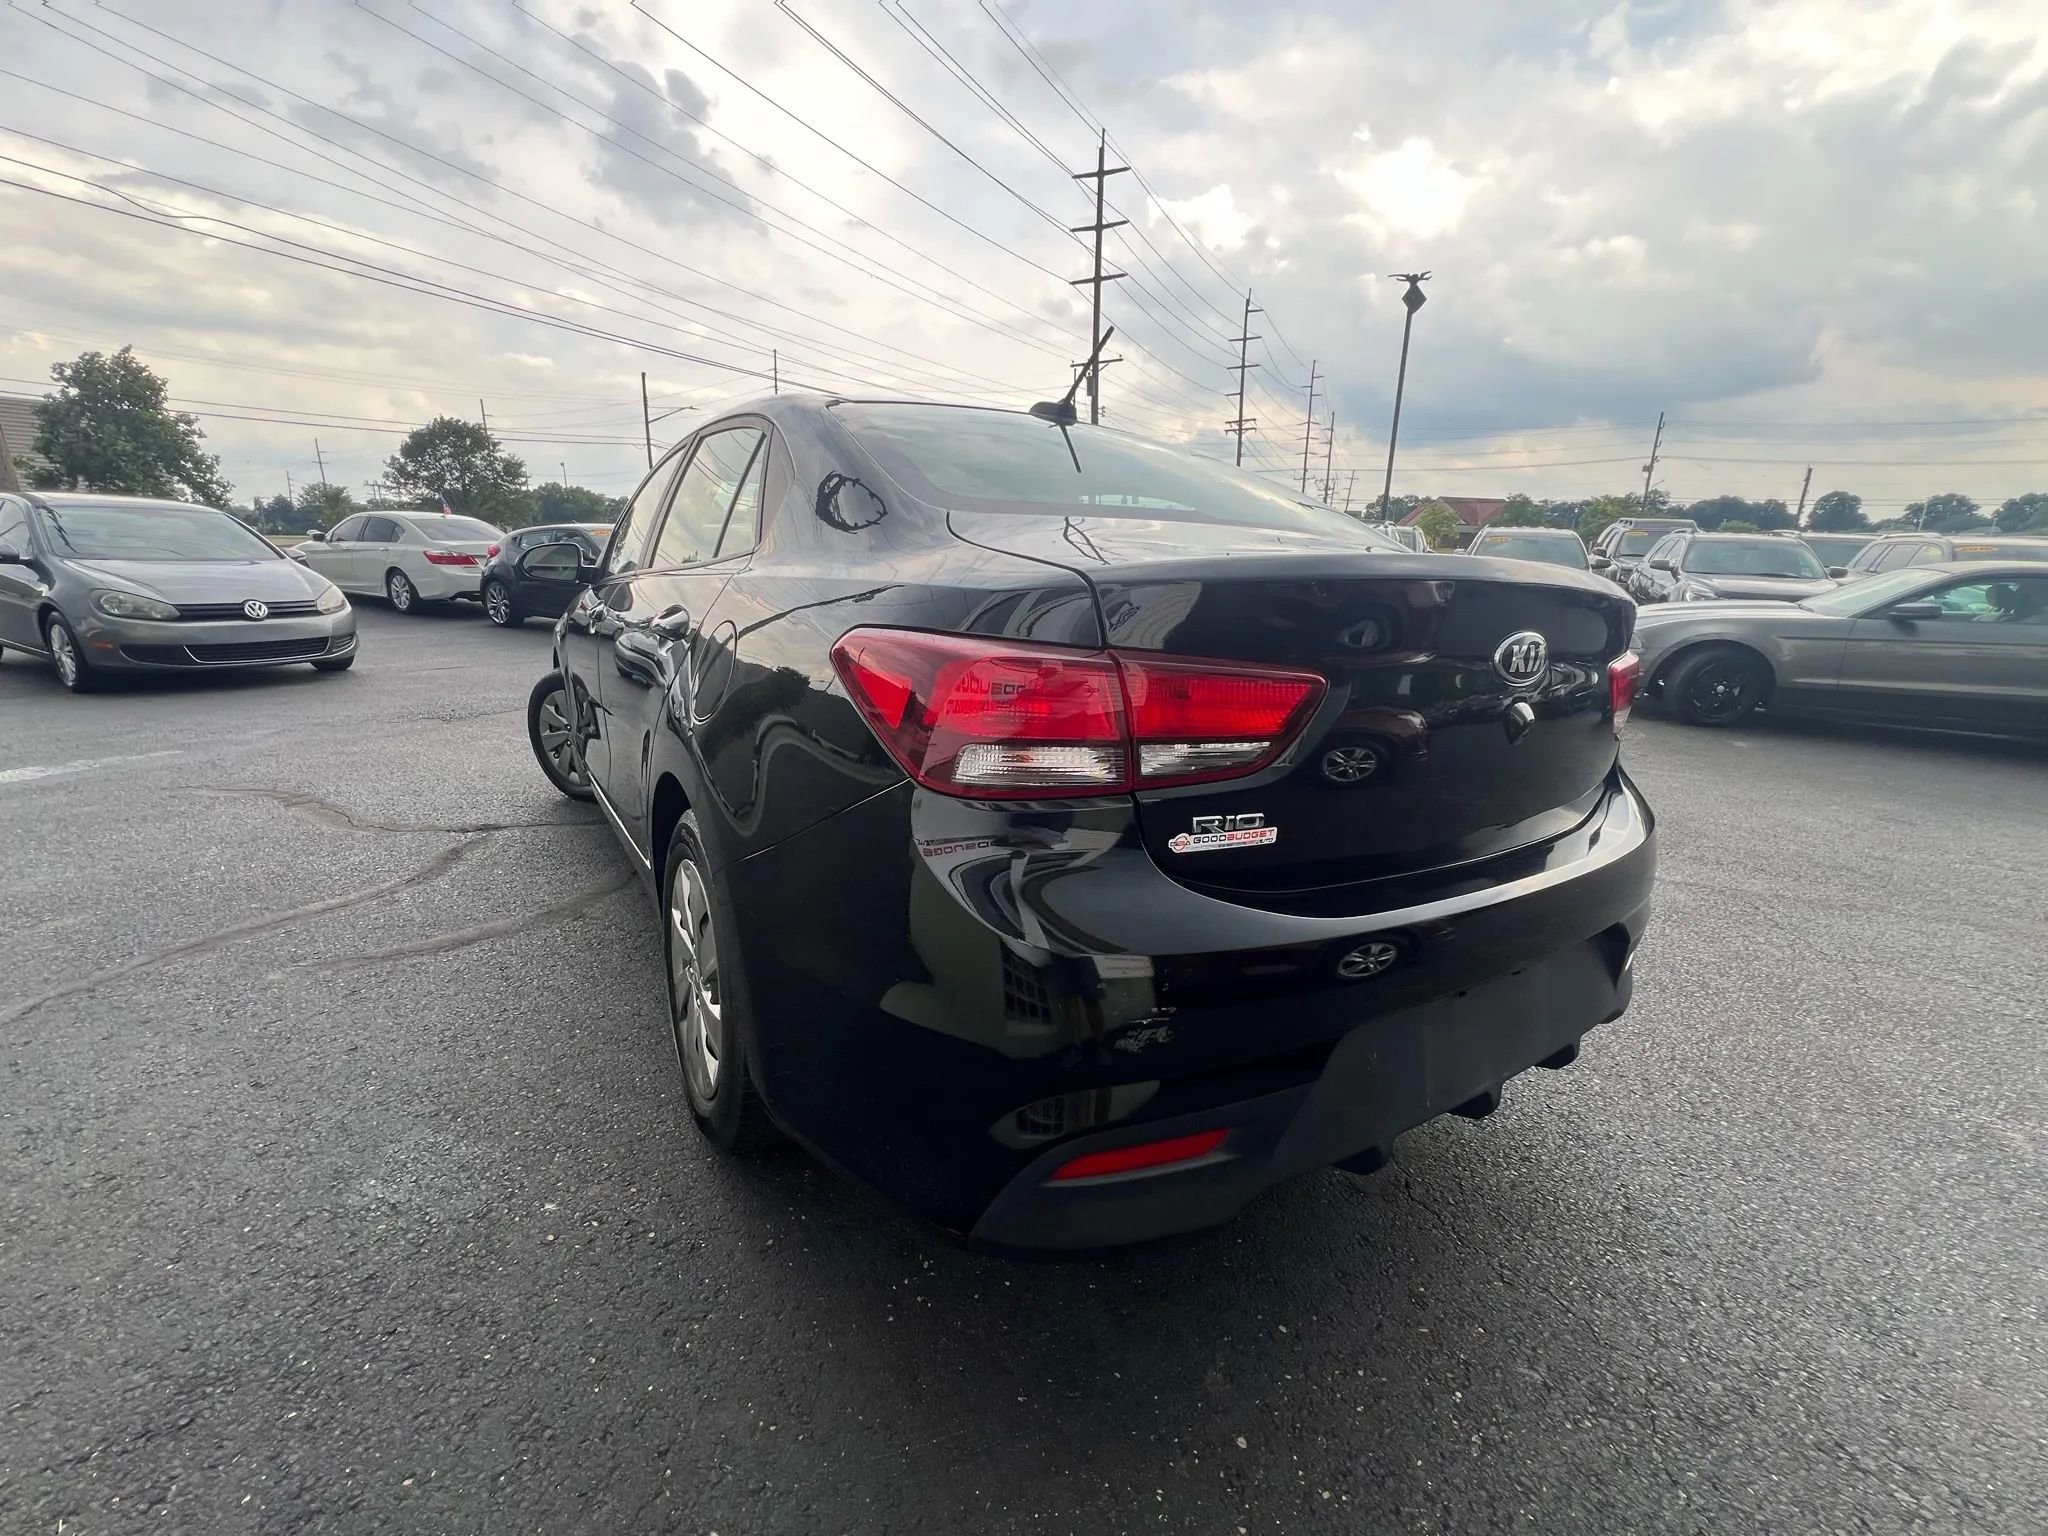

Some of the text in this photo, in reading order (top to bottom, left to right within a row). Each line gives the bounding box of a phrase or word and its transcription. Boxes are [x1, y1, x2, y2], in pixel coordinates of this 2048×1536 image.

[1509, 644, 1546, 673] KIA
[1191, 812, 1265, 833] RIO
[1193, 829, 1275, 844] GOODBUDGET
